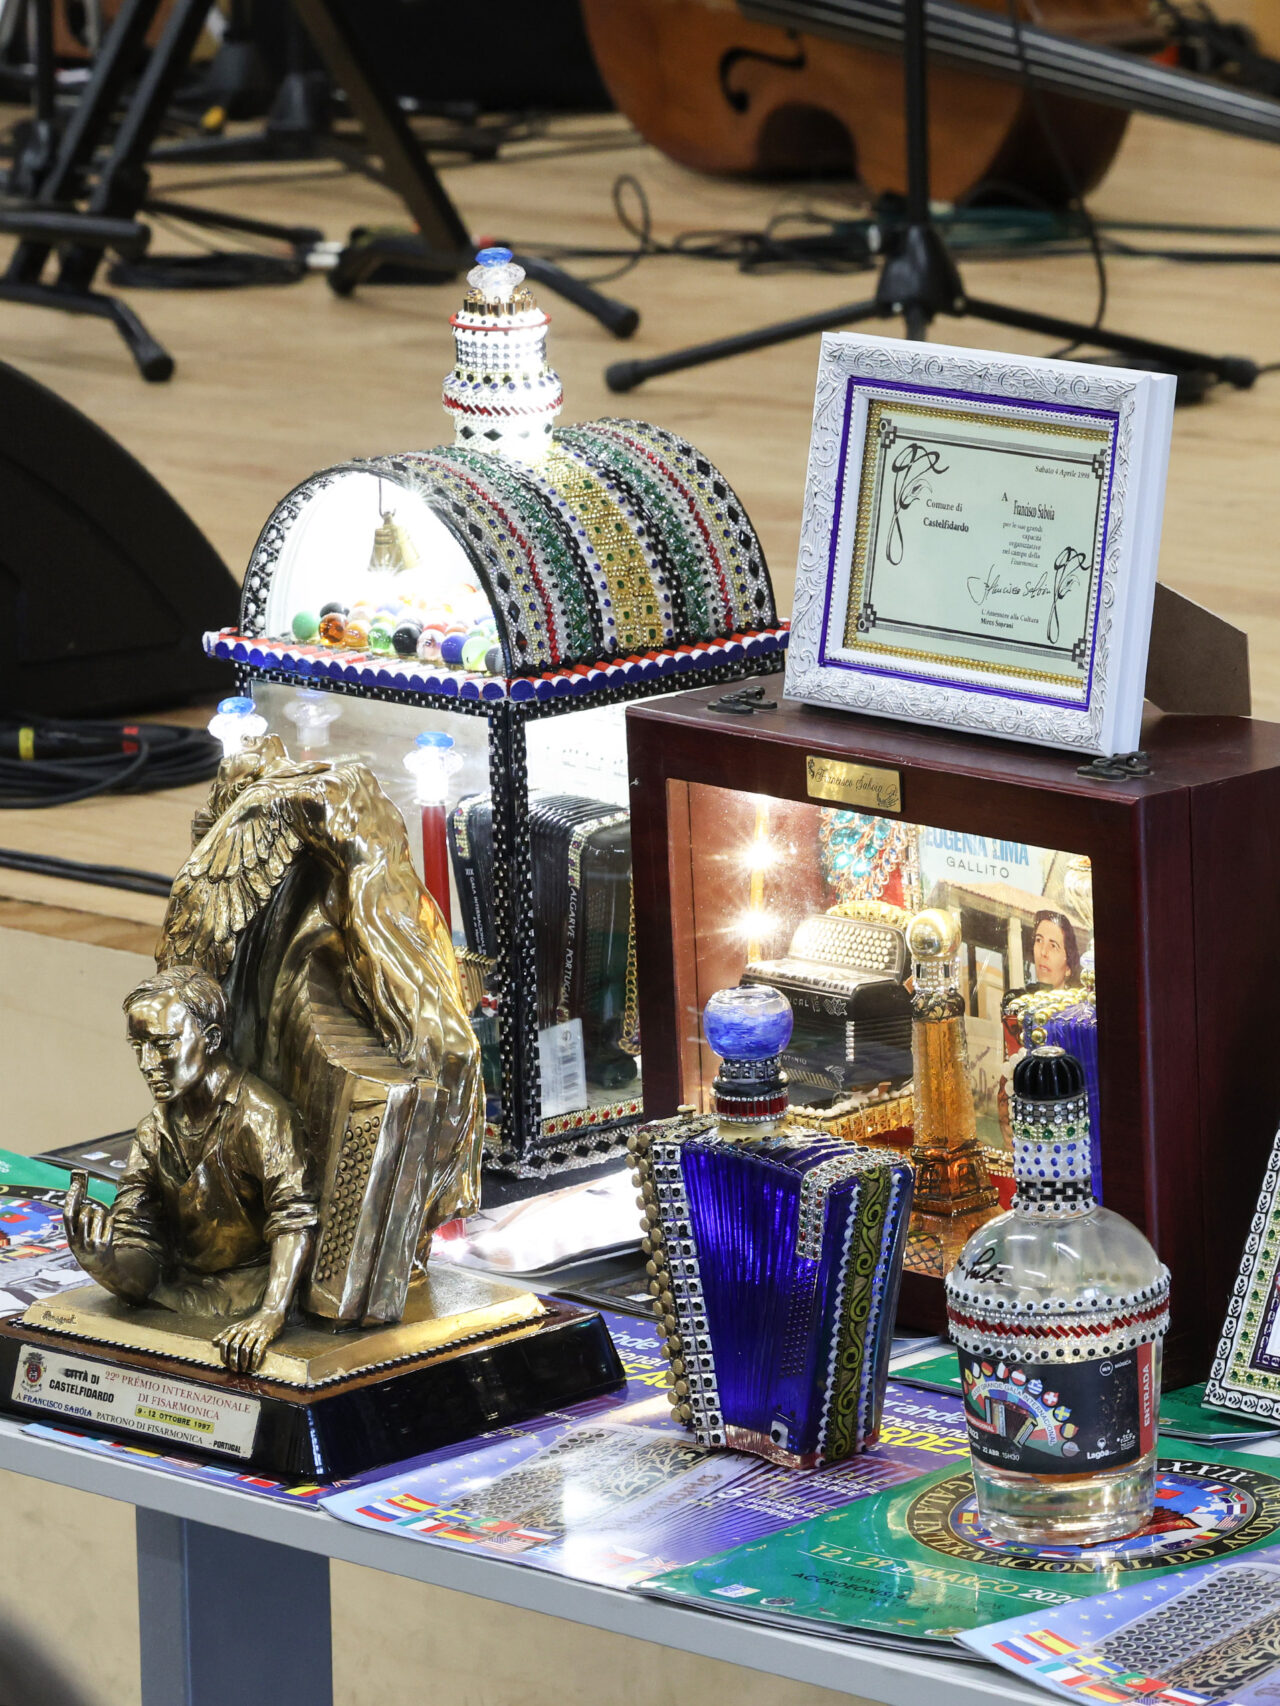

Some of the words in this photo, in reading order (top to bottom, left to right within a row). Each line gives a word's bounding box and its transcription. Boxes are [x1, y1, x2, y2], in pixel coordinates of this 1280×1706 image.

[1059, 469, 1077, 478] Aprile
[926, 499, 955, 512] Comune
[955, 502, 963, 513] di
[1001, 492, 1009, 502] A
[1013, 499, 1037, 518] Francisco
[923, 516, 970, 533] Castelfidardo
[1020, 614, 1039, 624] Cultura
[945, 855, 1010, 879] GALLITO
[566, 887, 578, 941] ALGARVE
[560, 947, 575, 1005] PORTUGAL
[64, 1368, 89, 1383] CITTÀ
[90, 1374, 100, 1386] DI
[49, 1379, 115, 1403] CASTELFIDARDO
[121, 1374, 161, 1393] PRÉMIO
[162, 1384, 252, 1414] INTERNAZIONALE
[1142, 1363, 1151, 1427] ENTRADA
[137, 1392, 149, 1404] DI
[151, 1395, 220, 1421] FISARMONICA
[883, 1398, 968, 1424] rande
[15, 1392, 21, 1400] A
[22, 1393, 63, 1411] FRANCISCO
[96, 1411, 136, 1428] PATRONO
[135, 1420, 148, 1432] DI
[147, 1423, 203, 1445] FISARMONICA
[212, 1439, 242, 1454] PORTUGAL
[137, 1407, 143, 1415] 9
[147, 1409, 157, 1418] 12
[158, 1411, 191, 1427] OTTOBRE
[193, 1420, 212, 1431] 1997
[1021, 1393, 1057, 1445] INTERNACIONAL
[1086, 1449, 1110, 1460] Lagoa
[1158, 1460, 1253, 1484] XXIX
[716, 1486, 755, 1499] 5
[914, 1480, 974, 1515] GALA
[809, 1544, 843, 1559] 12
[855, 1557, 896, 1569] 29
[913, 1519, 1153, 1574] INTERNACIONAL
[1163, 1548, 1216, 1567] DO
